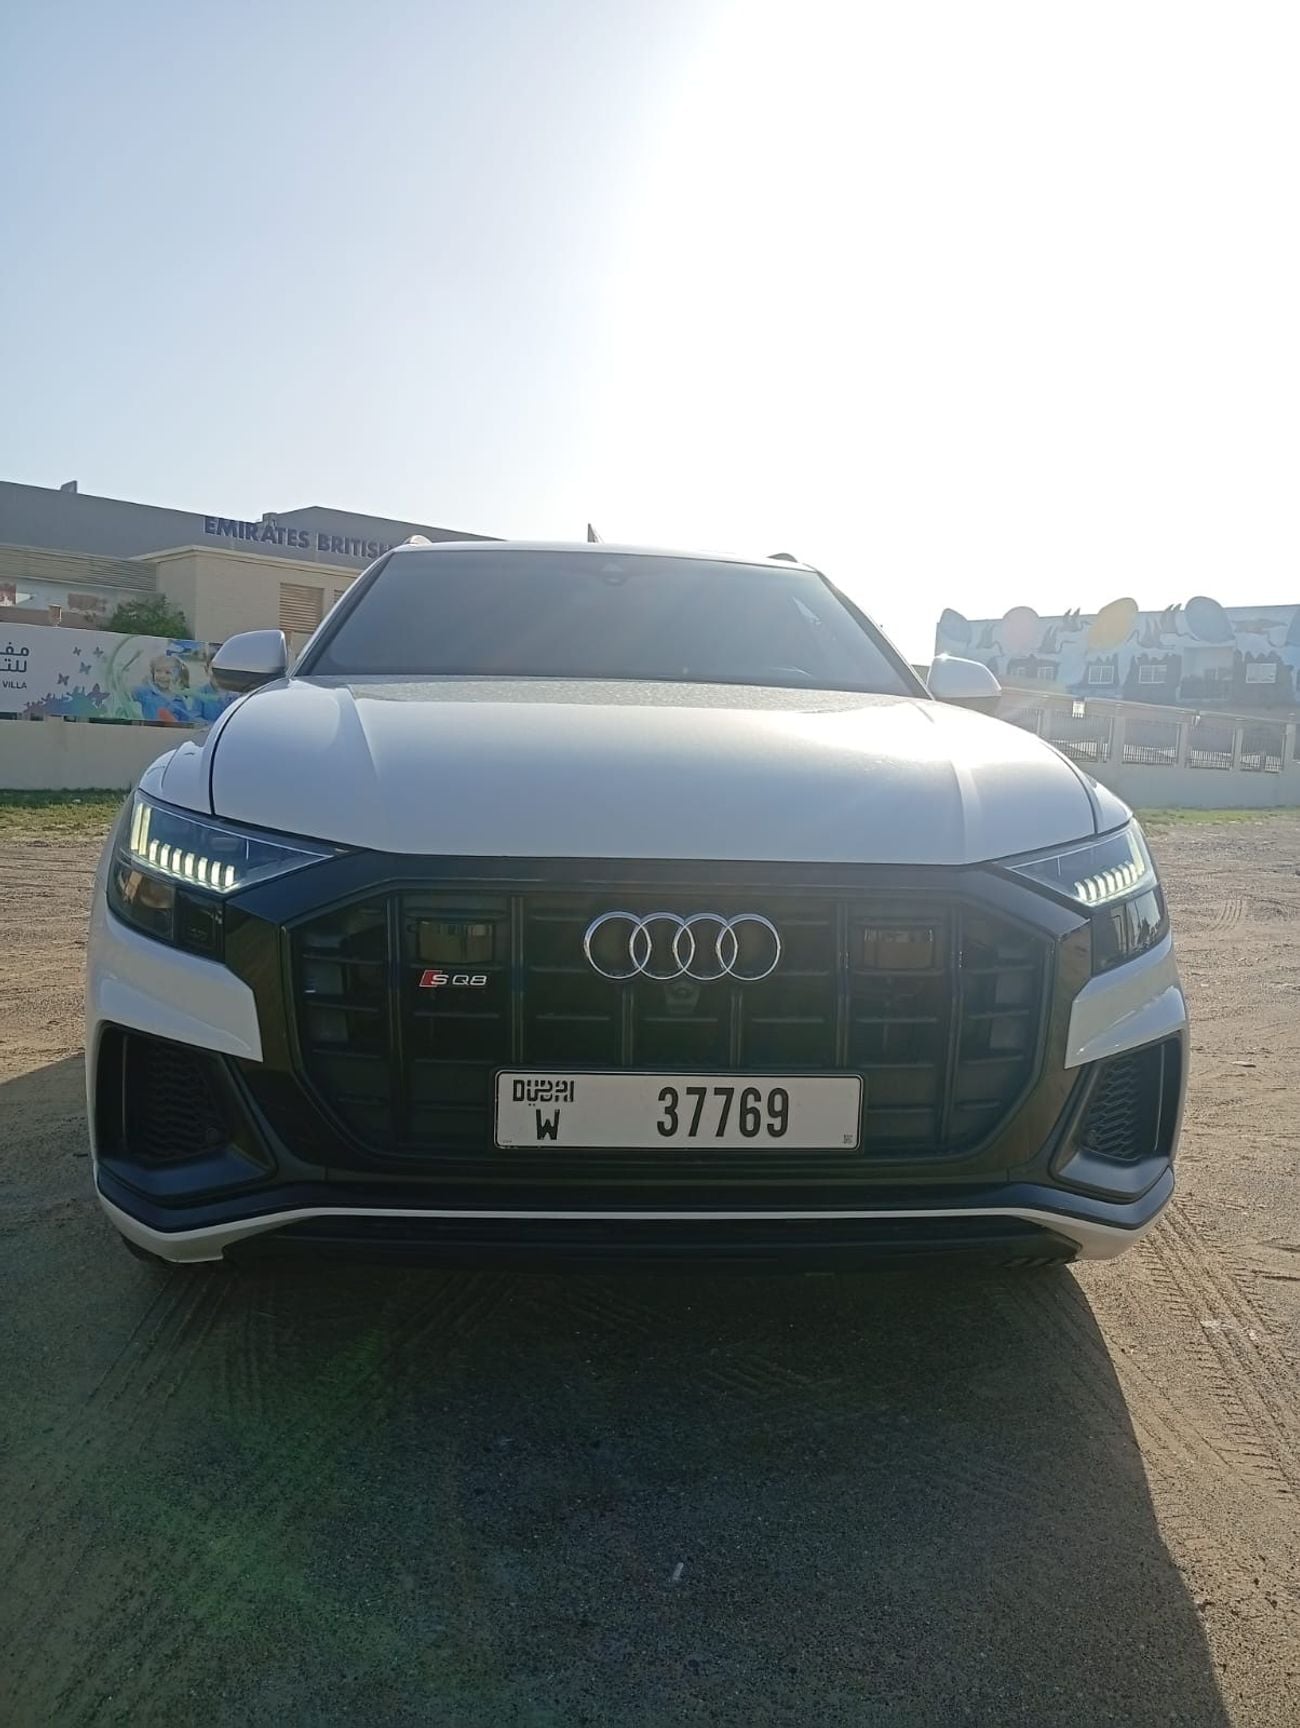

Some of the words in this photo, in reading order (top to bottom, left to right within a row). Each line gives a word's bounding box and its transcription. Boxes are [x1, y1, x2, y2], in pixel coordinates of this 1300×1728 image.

[204, 516, 309, 549] EMIRATES
[0, 642, 30, 657] مف
[0, 658, 27, 673] للت
[2, 680, 28, 690] VILLA
[512, 1079, 575, 1103] DUBAI
[656, 1086, 790, 1138] 37769
[535, 1109, 560, 1141] W
